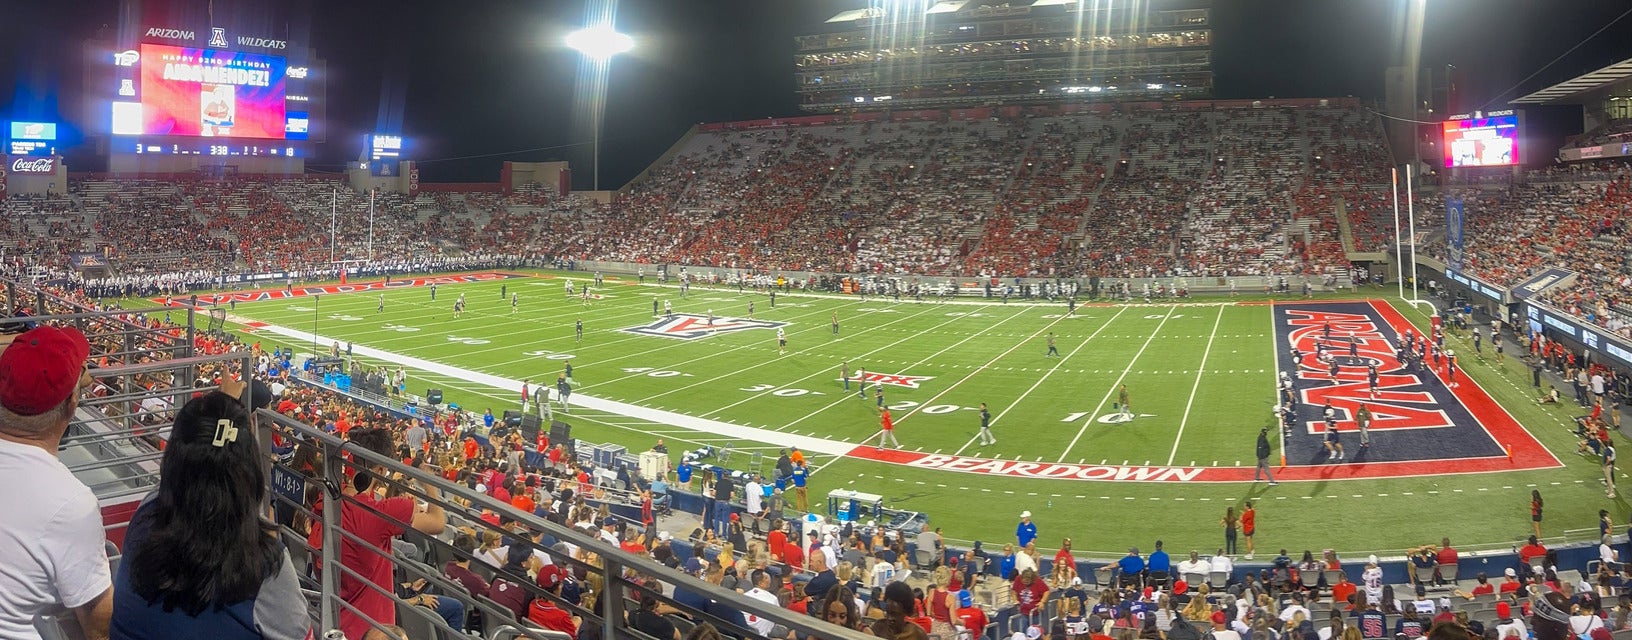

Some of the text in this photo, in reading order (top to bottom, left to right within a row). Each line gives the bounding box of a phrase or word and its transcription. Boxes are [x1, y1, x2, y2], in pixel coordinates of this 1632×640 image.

[145, 27, 195, 40] ARIZONA
[209, 27, 228, 48] A
[237, 36, 287, 49] WILDCATS
[162, 54, 193, 62] HAPPY
[227, 60, 271, 69] BIRTHDAY
[163, 63, 270, 87] AIDA MENDEZ!
[136, 144, 142, 153] 3
[210, 145, 228, 155] 3:38
[12, 158, 55, 172] Coca-Cola
[1285, 309, 1457, 435] ARIZONA
[739, 384, 809, 397] 30
[886, 401, 961, 414] 20
[1060, 411, 1136, 424] 10
[1363, 618, 1383, 637] 56
